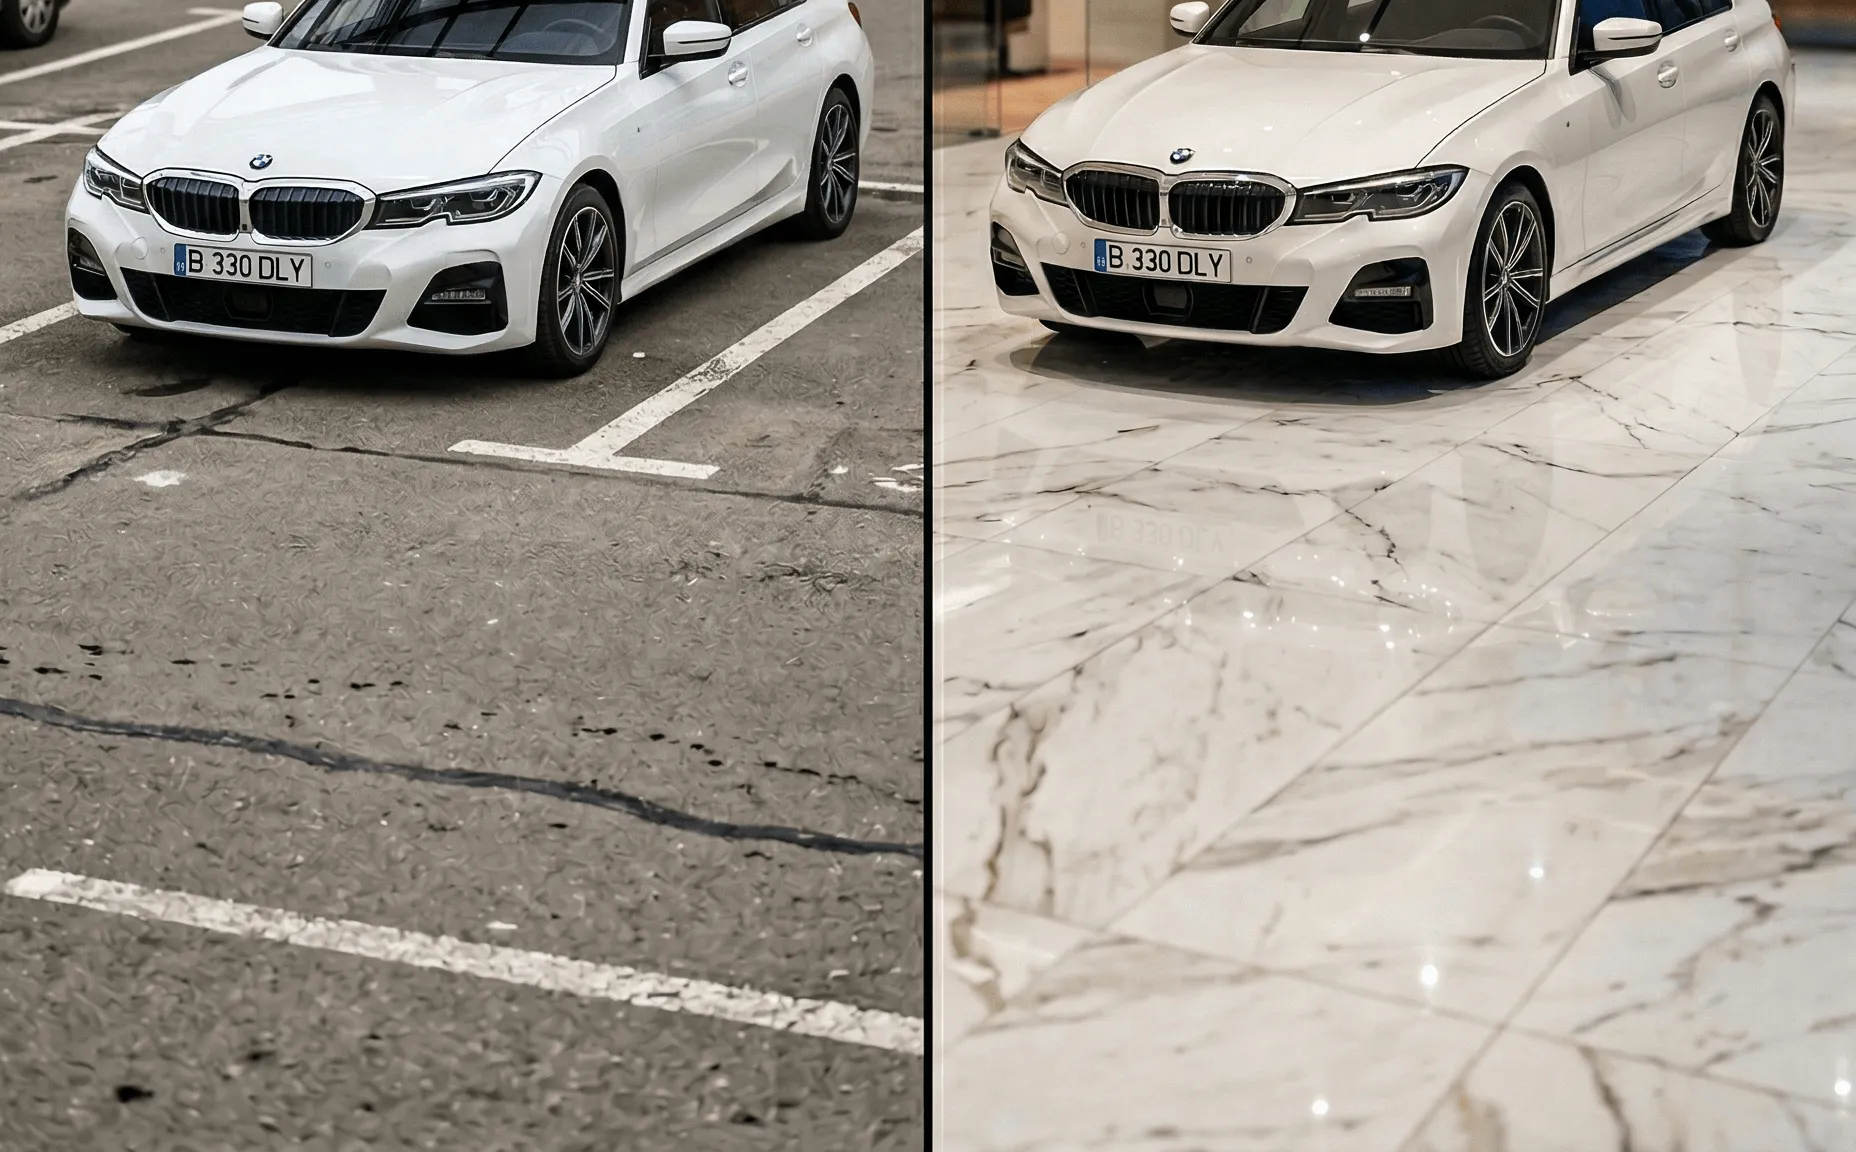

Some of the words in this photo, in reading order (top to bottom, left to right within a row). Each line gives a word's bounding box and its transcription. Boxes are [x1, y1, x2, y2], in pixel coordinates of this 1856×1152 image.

[188, 248, 204, 274] B
[212, 251, 252, 278] 330
[258, 255, 305, 283] DLY
[1108, 244, 1124, 269] B
[1131, 247, 1172, 273] 330
[1177, 250, 1223, 278] DLY
